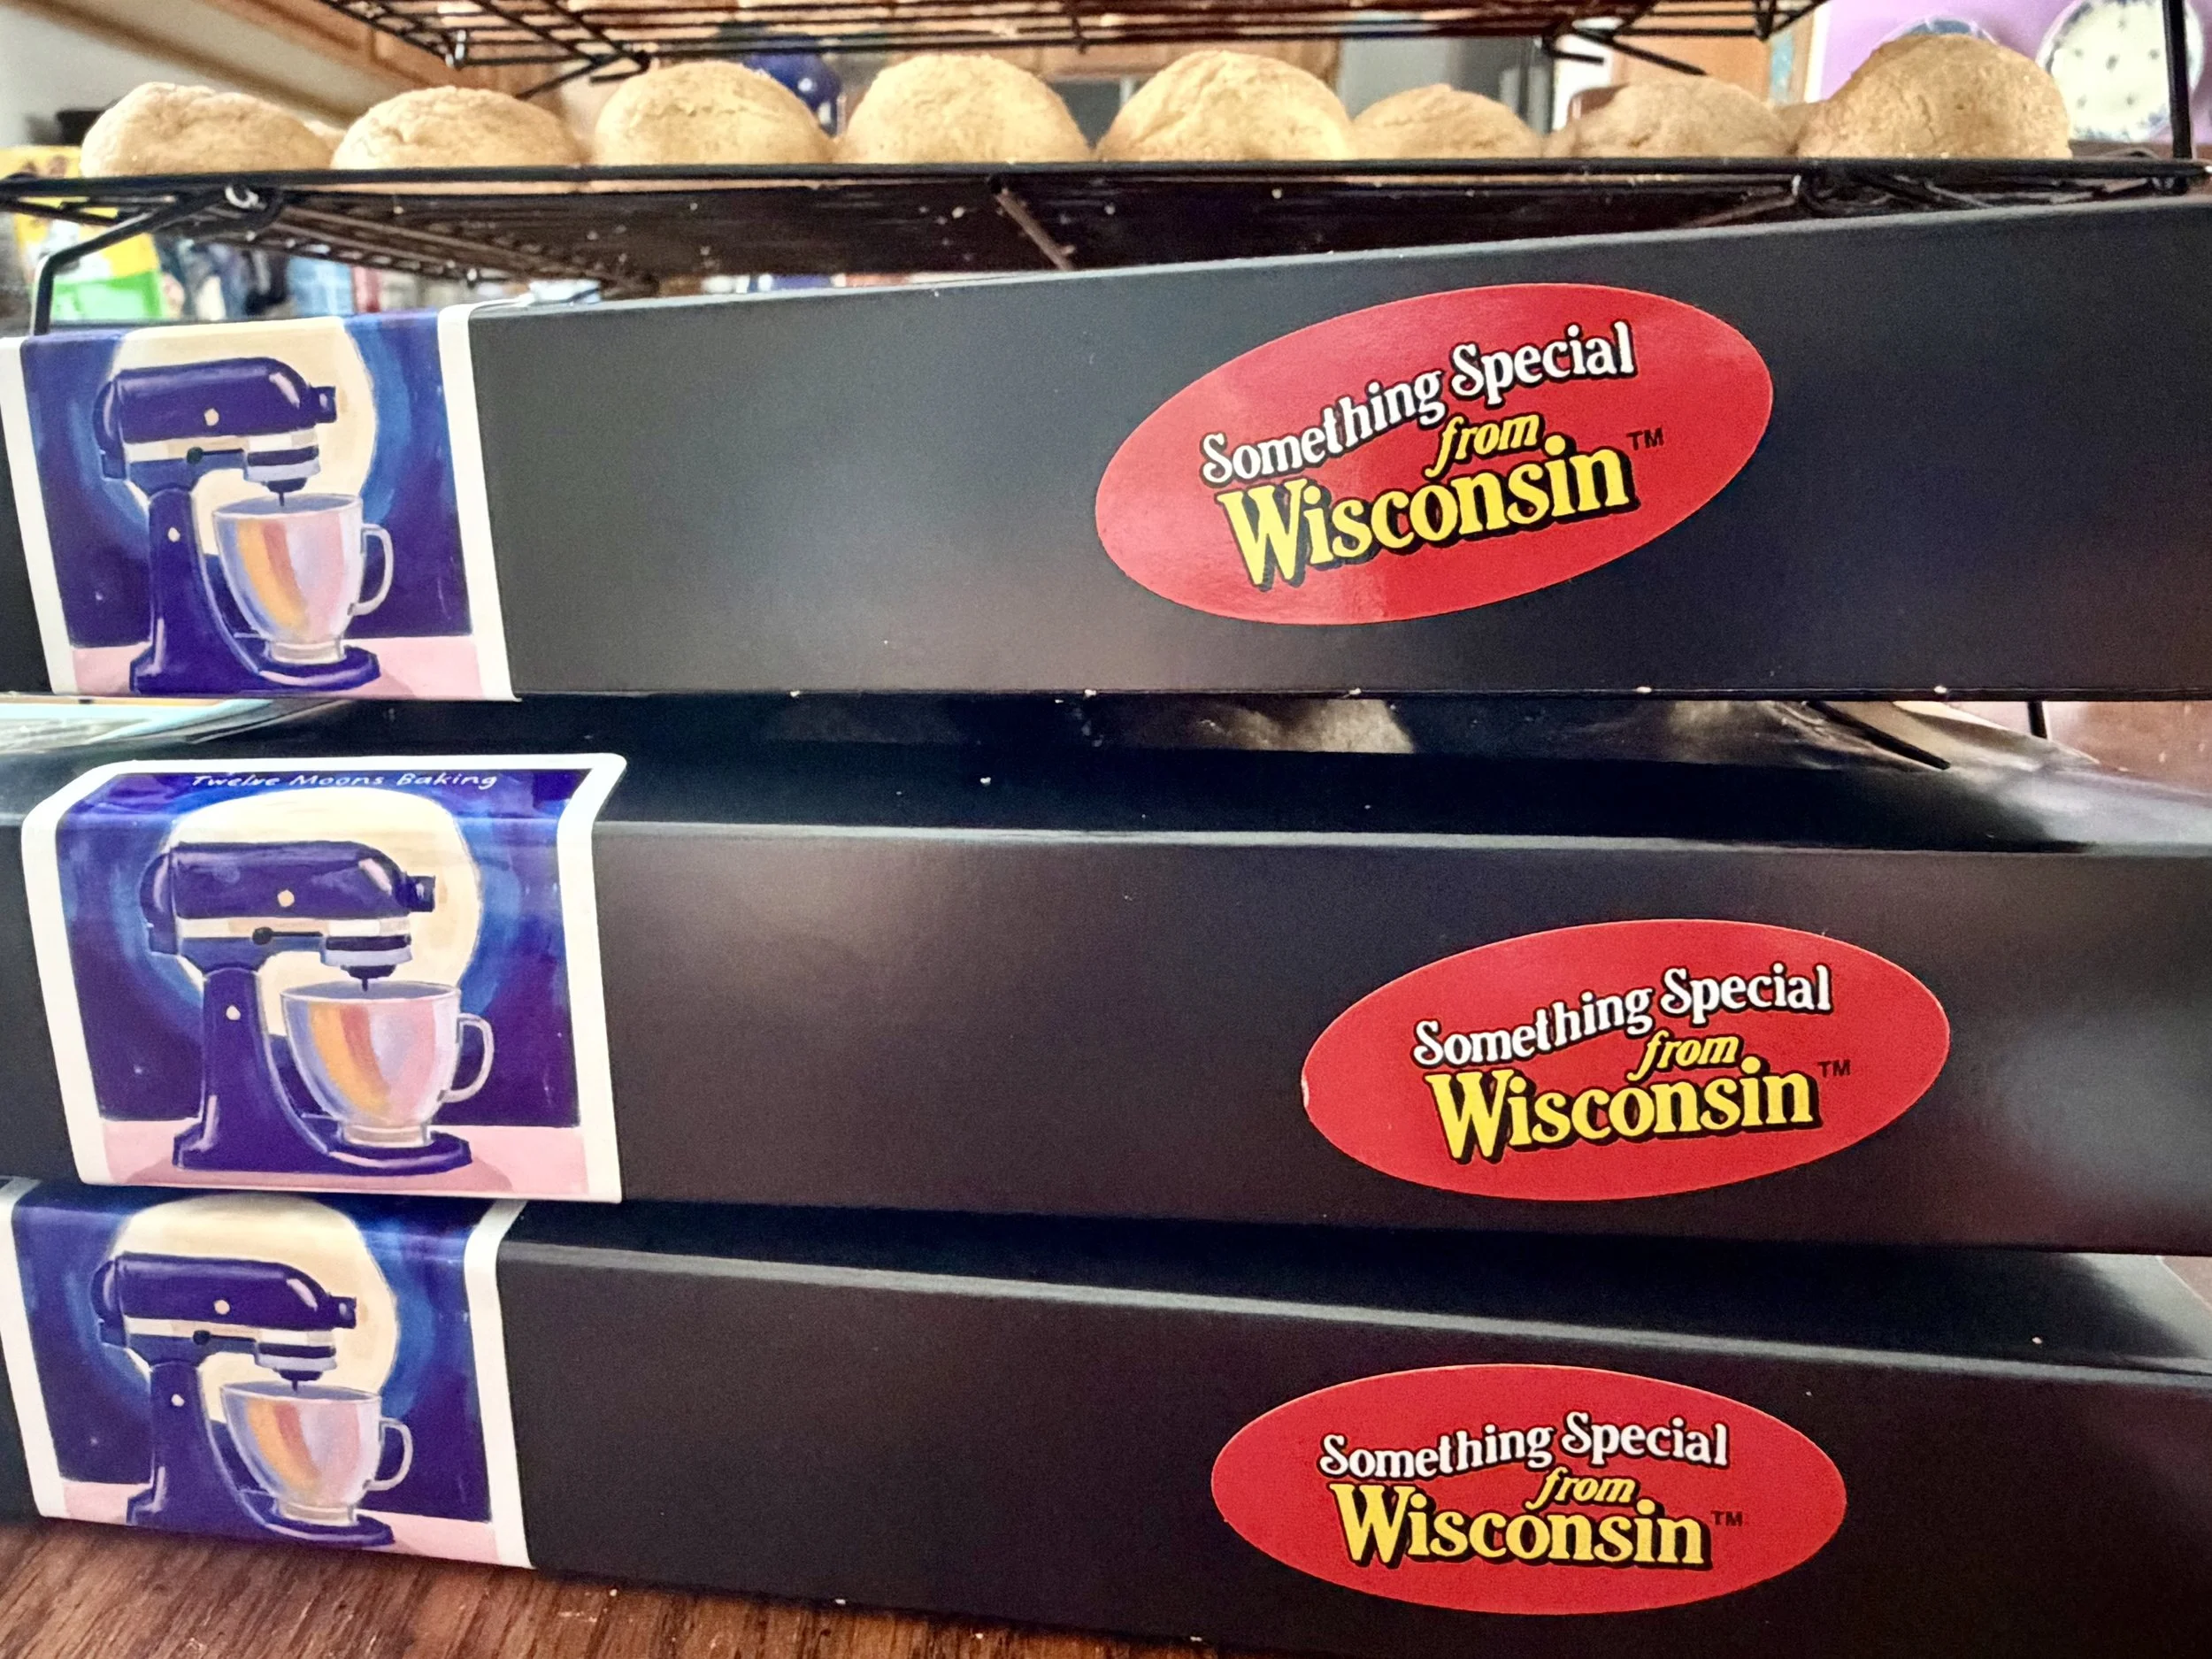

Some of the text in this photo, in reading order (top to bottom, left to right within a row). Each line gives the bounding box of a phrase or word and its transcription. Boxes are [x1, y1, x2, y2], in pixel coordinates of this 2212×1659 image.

[1201, 320, 1635, 483] Something Special
[1425, 413, 1542, 477] from
[1217, 434, 1636, 588] Wisconsin
[191, 772, 497, 790] Twelve Moons Baking
[1412, 964, 1832, 1064] Something Special
[1627, 1029, 1740, 1081] from
[1425, 1056, 1821, 1162] Wisconsin
[1318, 1411, 1729, 1479] Something Special
[1330, 1483, 1712, 1569] Wisconsin
[1525, 1466, 1637, 1509] from
